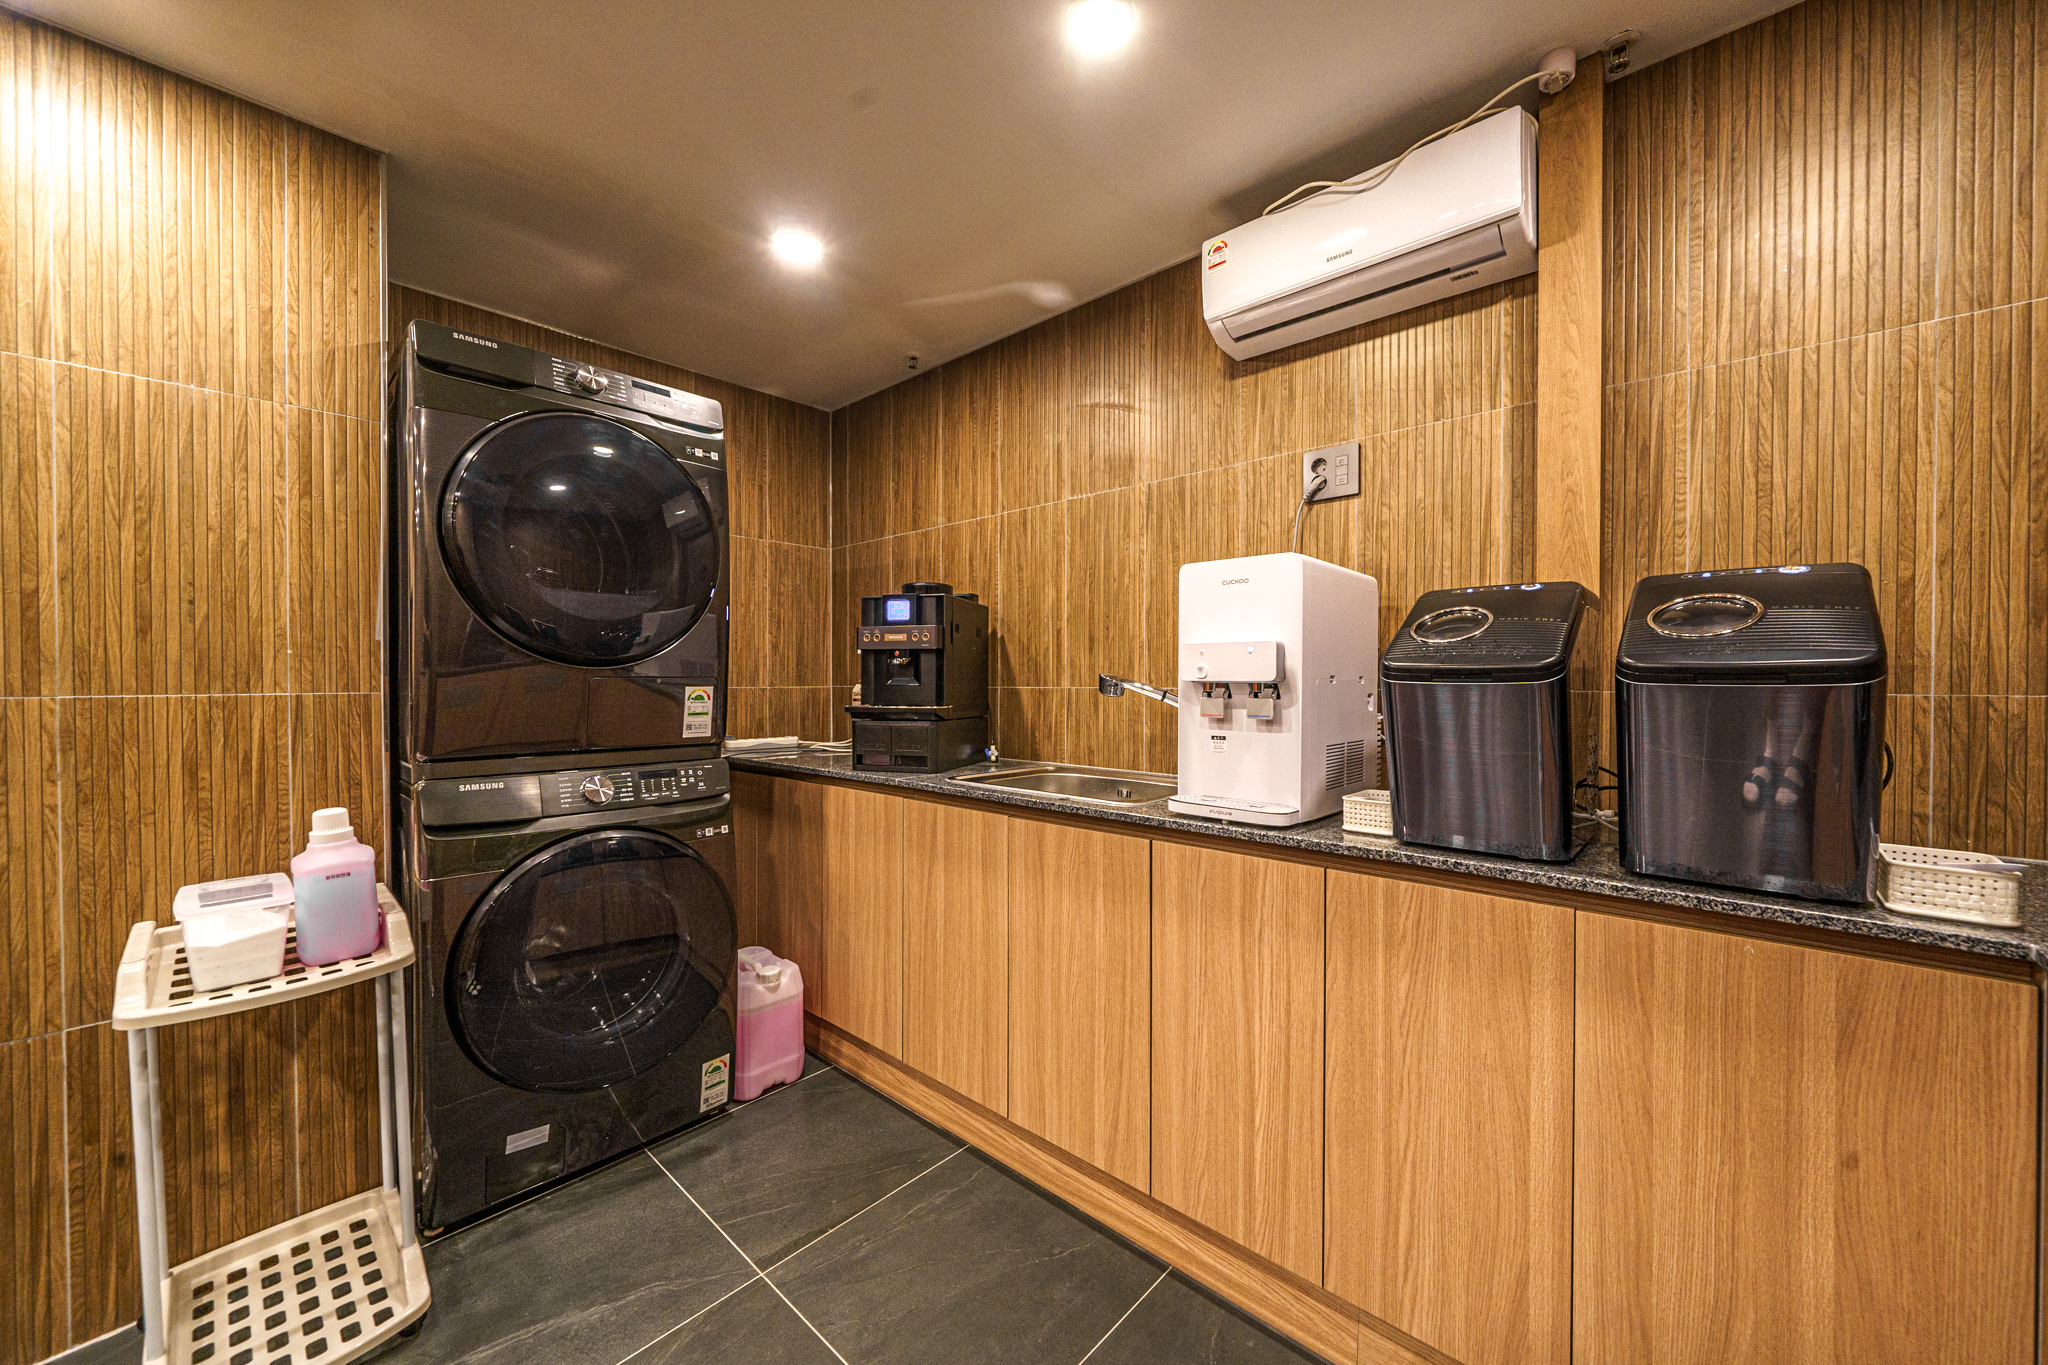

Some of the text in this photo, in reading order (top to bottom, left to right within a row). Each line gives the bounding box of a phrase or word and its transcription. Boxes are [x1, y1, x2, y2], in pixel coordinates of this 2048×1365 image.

[1326, 249, 1353, 263] SAMSUNG
[452, 332, 498, 348] SAMSUNG
[1221, 578, 1250, 586] CUCKOO
[458, 782, 505, 792] SAMSUNG
